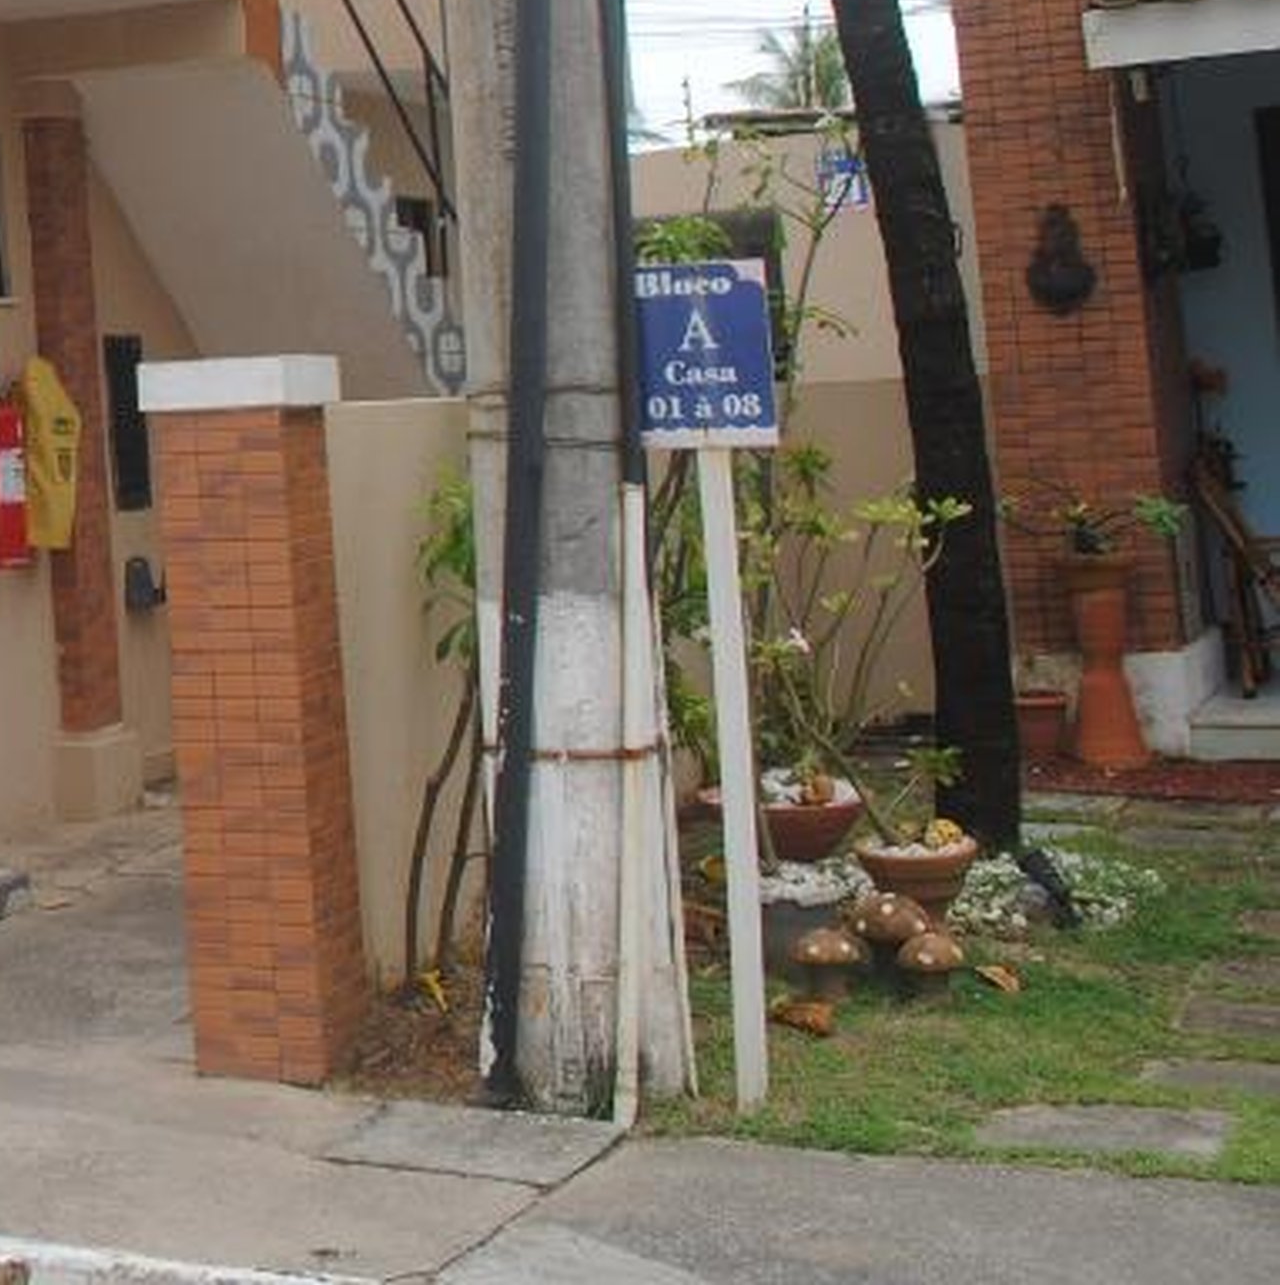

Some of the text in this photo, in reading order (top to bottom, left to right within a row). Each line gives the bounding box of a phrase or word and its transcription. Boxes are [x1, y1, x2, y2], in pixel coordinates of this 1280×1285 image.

[634, 271, 732, 299] Bloco
[679, 309, 719, 351] A
[665, 360, 738, 384] Casa
[648, 397, 684, 420] 01
[722, 393, 762, 418] 08
